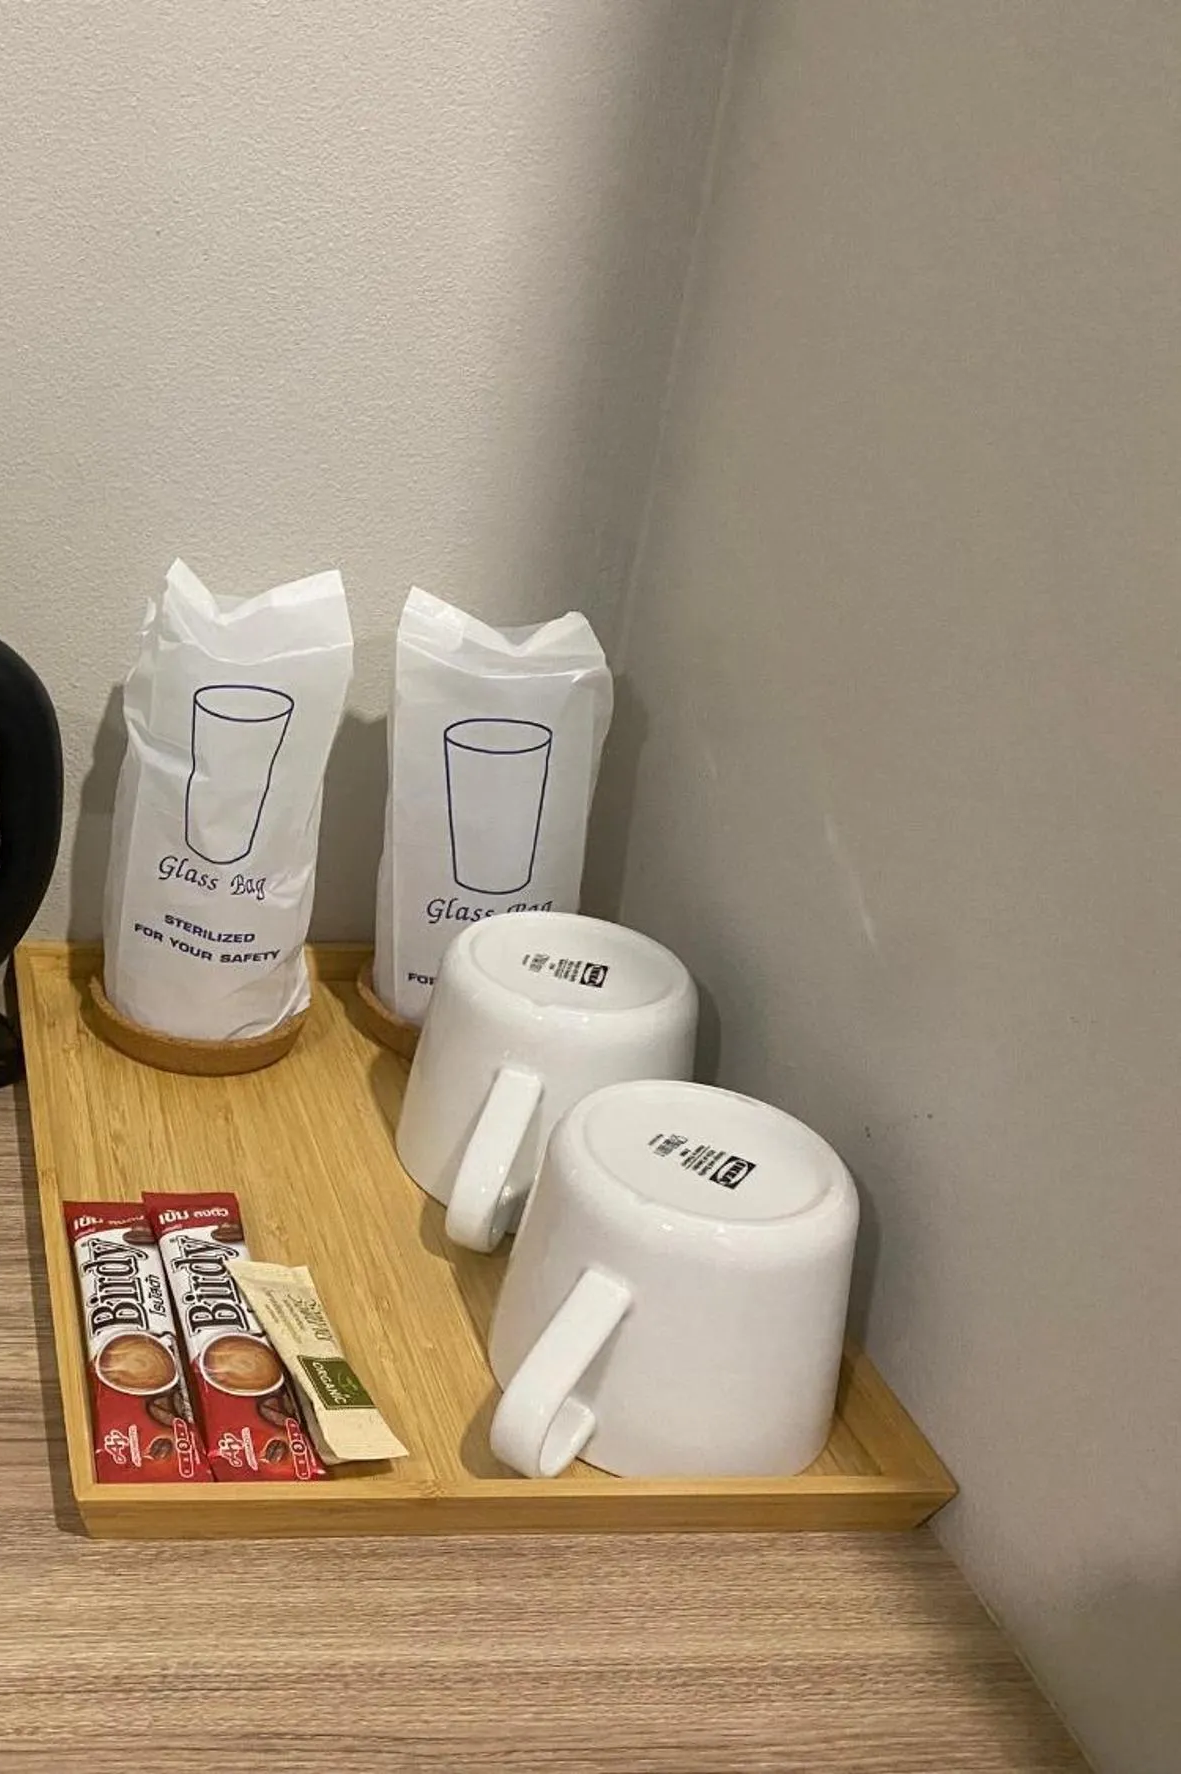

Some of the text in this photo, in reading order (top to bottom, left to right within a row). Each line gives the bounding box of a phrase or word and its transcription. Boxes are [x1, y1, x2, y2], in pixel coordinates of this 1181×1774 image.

[158, 855, 267, 900] Glass Bag
[134, 922, 281, 963] FOR YOUR SAFETY
[164, 914, 256, 943] STERILIZED
[81, 1238, 150, 1338] Birdy
[171, 1235, 250, 1338] Birdy
[312, 1361, 351, 1404] ORGANIC
